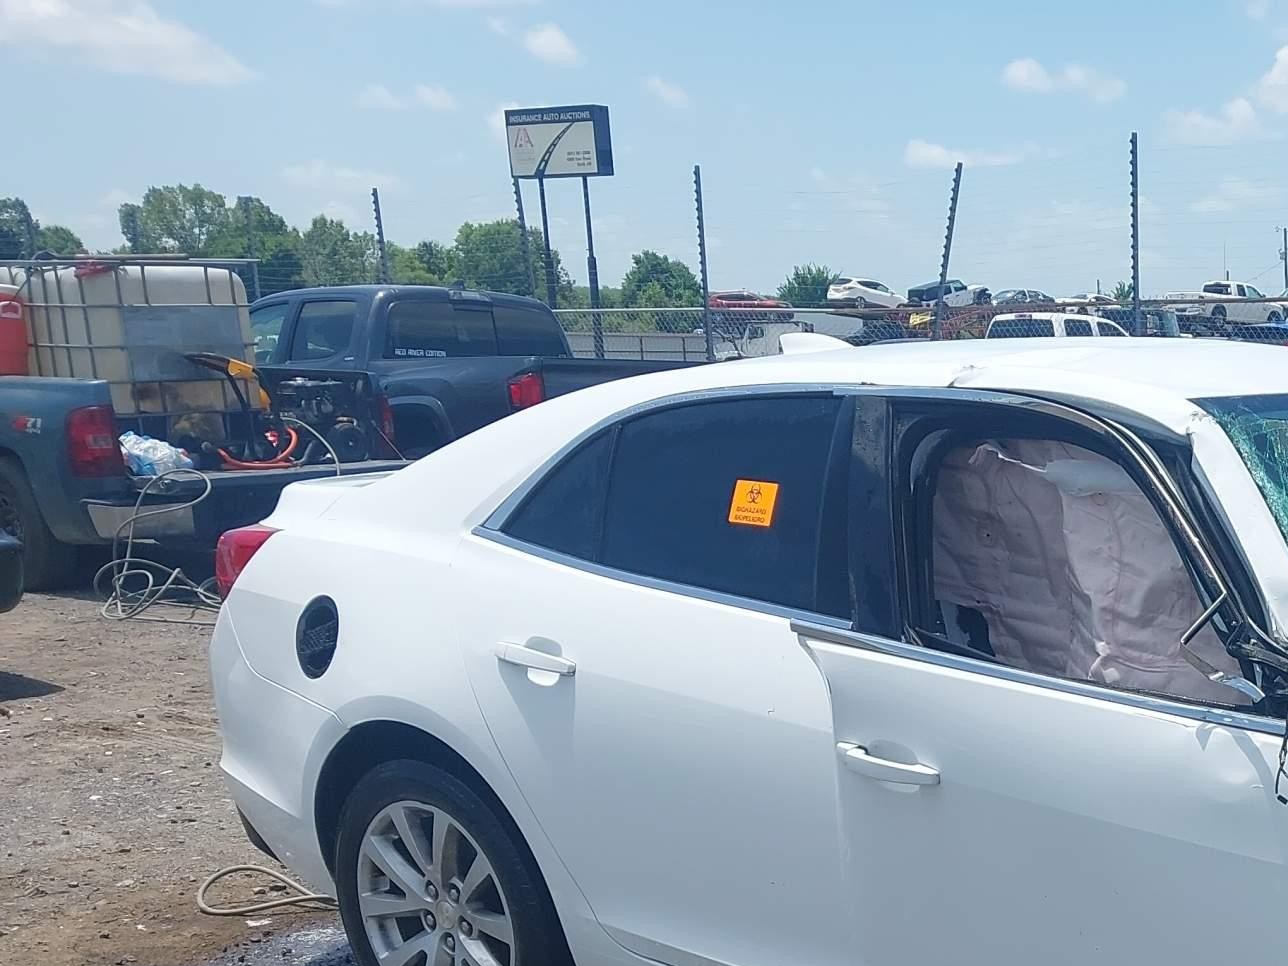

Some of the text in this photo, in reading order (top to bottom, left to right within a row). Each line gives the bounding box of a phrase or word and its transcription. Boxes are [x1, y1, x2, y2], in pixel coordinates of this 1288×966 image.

[509, 114, 541, 122] INSURANCE
[560, 111, 590, 119] AUCTIONS
[735, 506, 767, 515] BIOHAZARD
